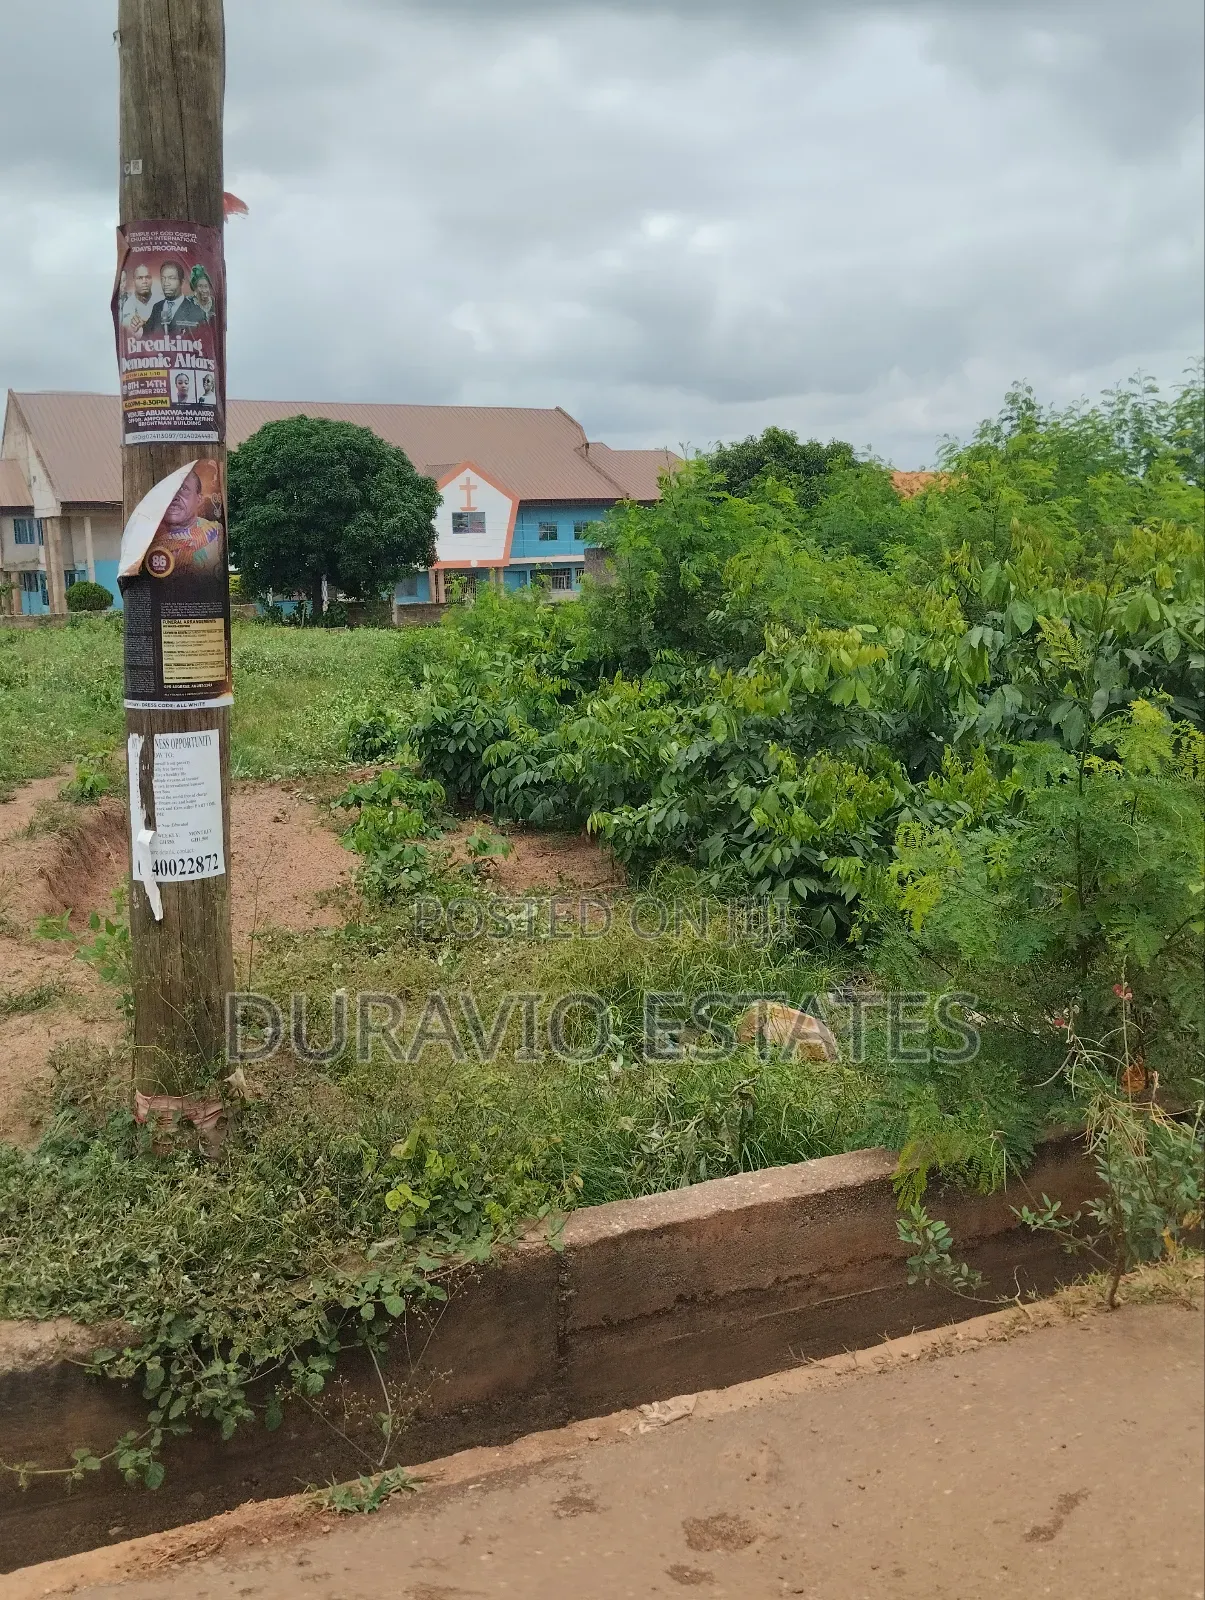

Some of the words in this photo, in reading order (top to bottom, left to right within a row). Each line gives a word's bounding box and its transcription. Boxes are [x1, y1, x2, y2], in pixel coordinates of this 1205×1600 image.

[127, 335, 203, 356] Breaking
[174, 353, 215, 370] Altars
[152, 555, 166, 566] 86
[171, 734, 212, 749] OPPORTUNITY
